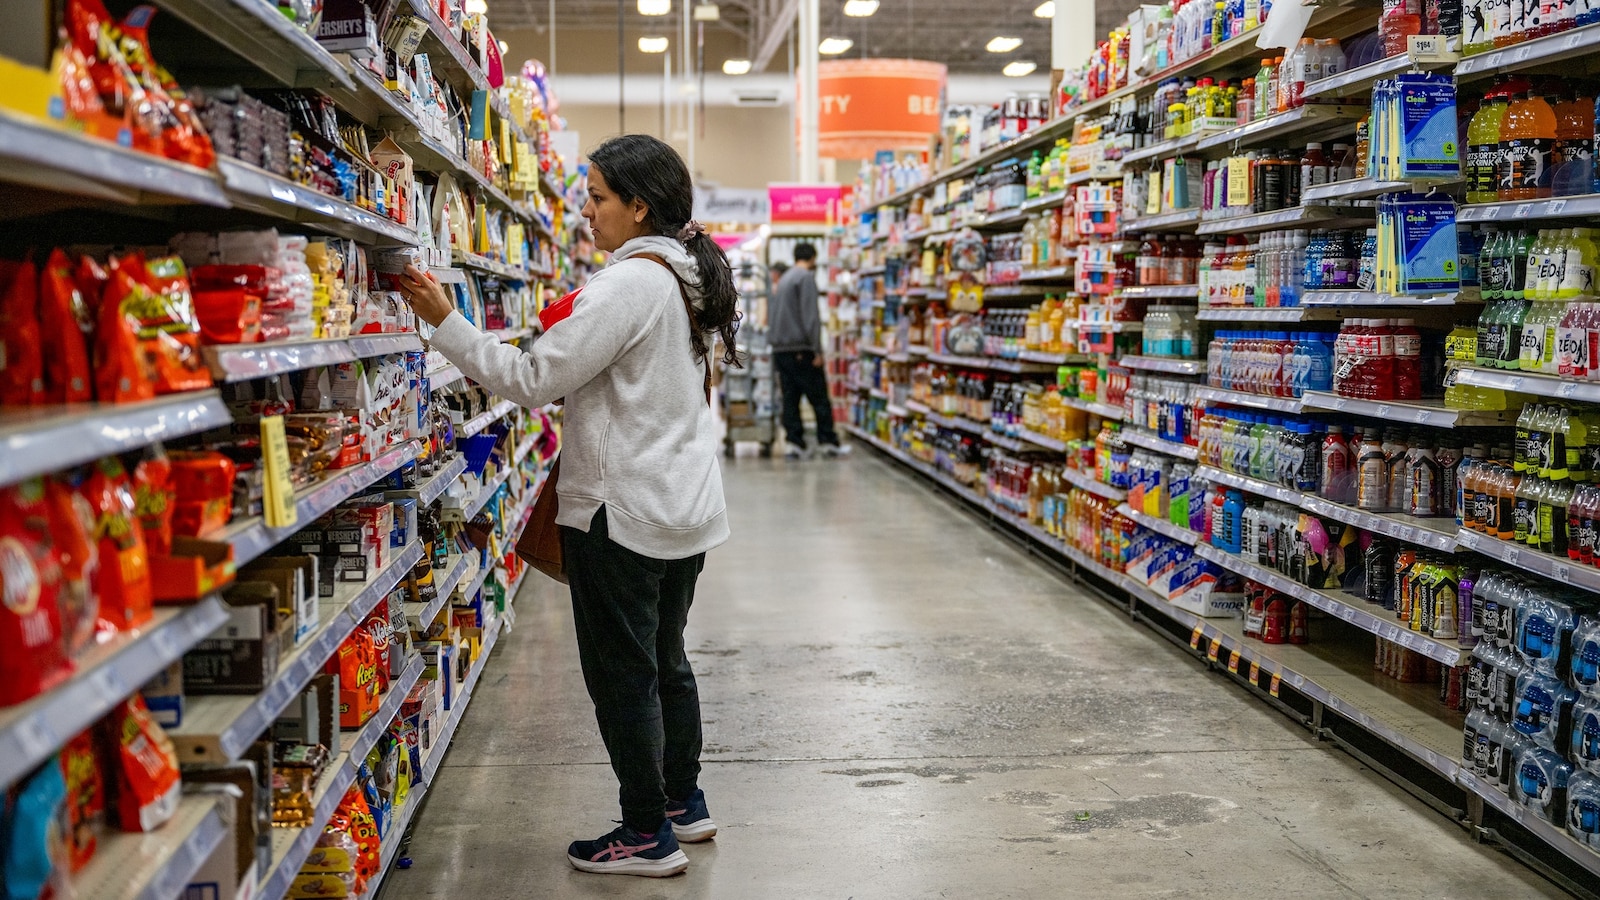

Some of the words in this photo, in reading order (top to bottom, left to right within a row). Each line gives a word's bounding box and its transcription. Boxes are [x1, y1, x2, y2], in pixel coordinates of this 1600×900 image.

[819, 96, 851, 114] TY
[1406, 95, 1427, 103] Clean
[1406, 214, 1427, 222] Clean
[1537, 263, 1556, 278] ZEO
[1520, 335, 1536, 348] ZEO
[1559, 339, 1578, 353] ZEO
[328, 530, 360, 540] HERSHEY'S
